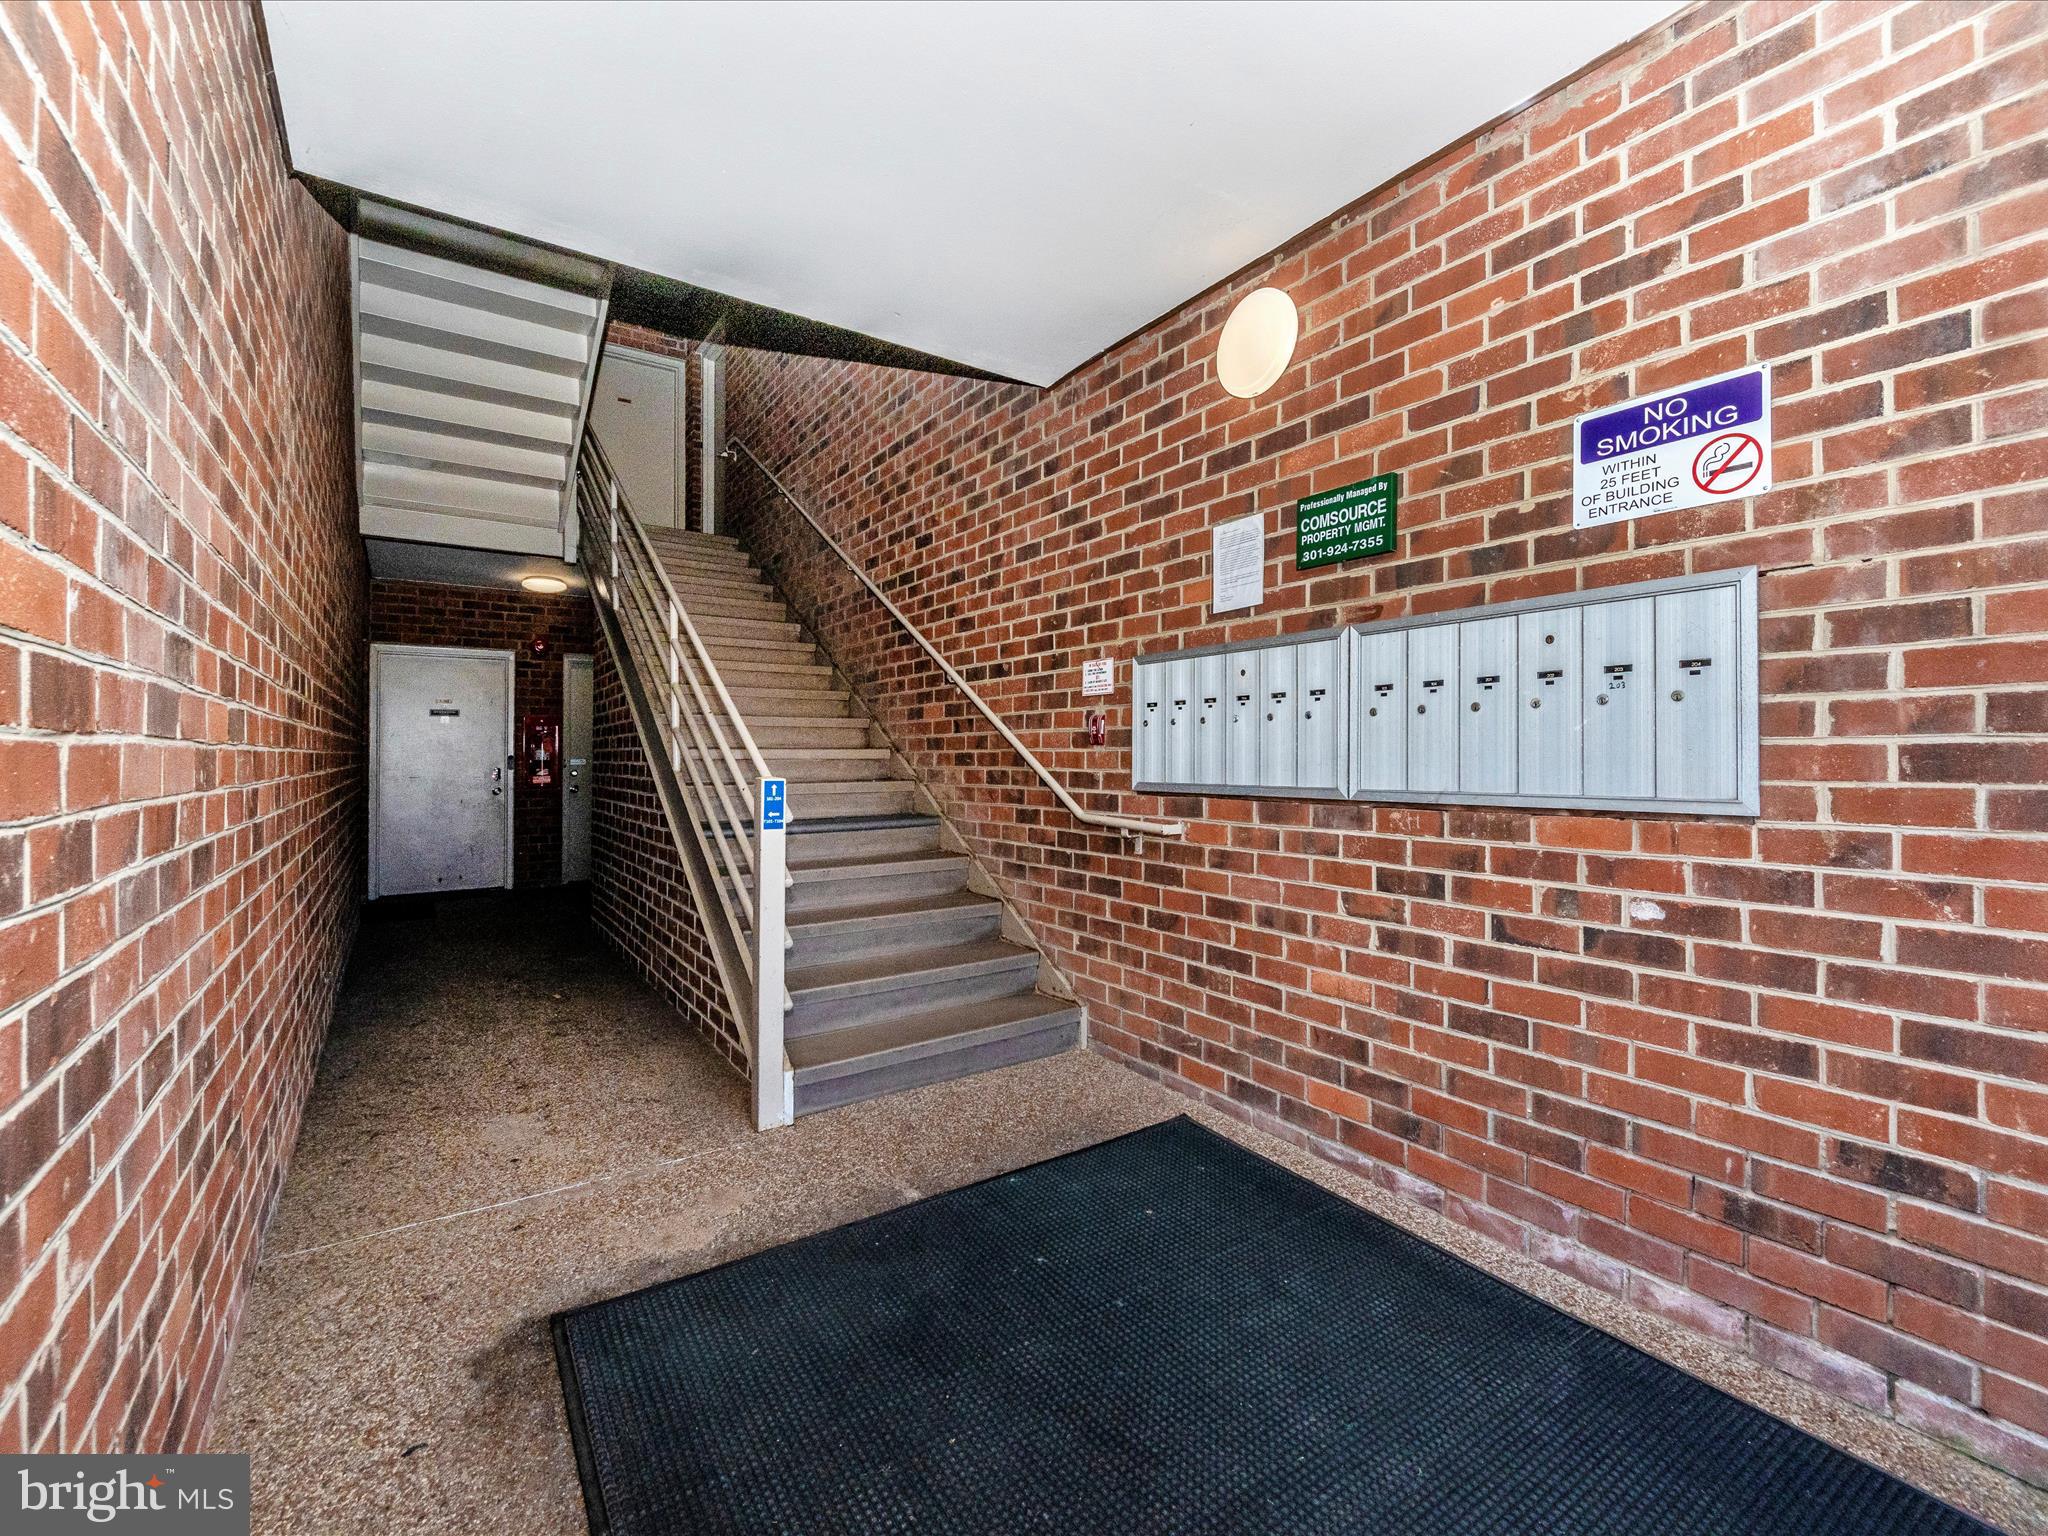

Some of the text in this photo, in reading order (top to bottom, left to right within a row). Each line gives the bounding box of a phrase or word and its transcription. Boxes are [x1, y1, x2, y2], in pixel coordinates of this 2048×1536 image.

[1644, 397, 1688, 425] NO
[1596, 405, 1739, 457] SMOKING
[1600, 466, 1661, 490] 25 FEET
[1602, 453, 1657, 476] WITHIN
[1300, 481, 1388, 512] Professionally Managed By
[1581, 476, 1680, 507] OF BUILDING
[1588, 491, 1673, 519] ENTRANCE
[1301, 498, 1387, 533] COMSOURCE
[1301, 516, 1386, 546] PROPERTY MGMT.
[1303, 535, 1384, 562] 301-924-7355
[1609, 681, 1626, 690] 203
